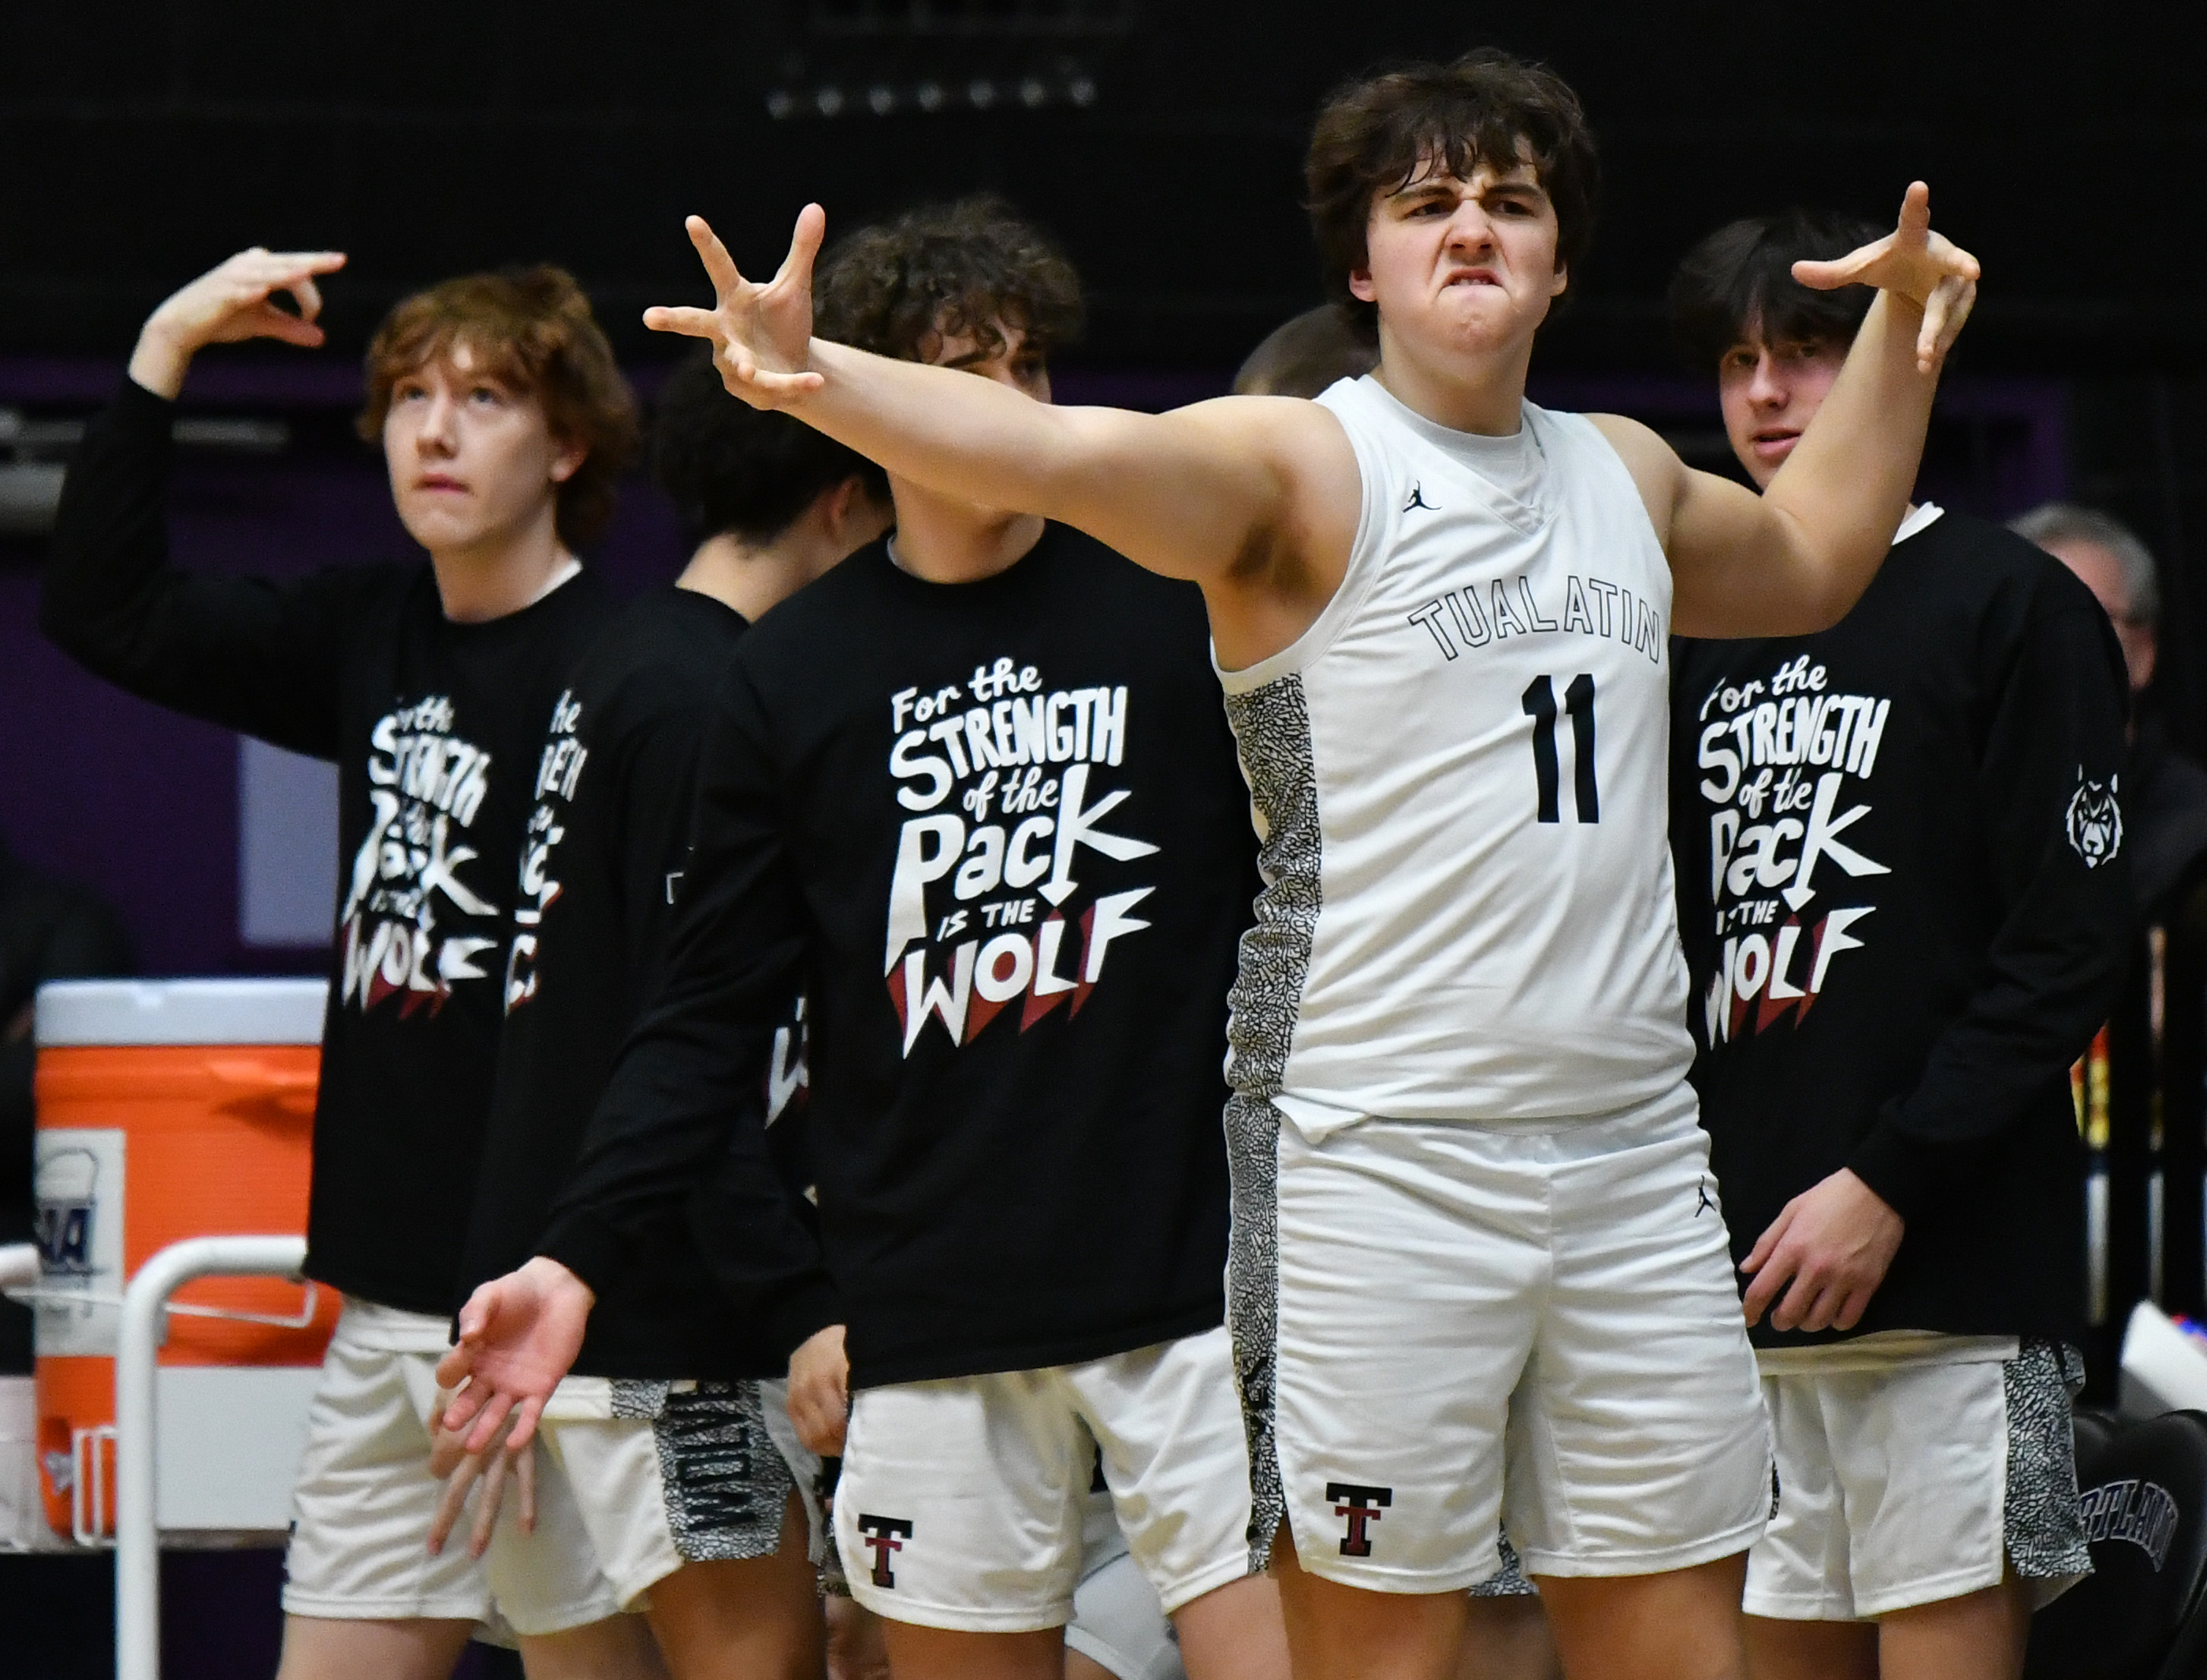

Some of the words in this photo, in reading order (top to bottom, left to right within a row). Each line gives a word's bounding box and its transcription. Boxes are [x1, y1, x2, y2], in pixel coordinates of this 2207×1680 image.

[1406, 575, 1661, 665] TUALATIN
[890, 686, 962, 734] For
[968, 656, 1043, 703] the
[1771, 654, 1829, 697] the
[888, 685, 1129, 812] STRENGTH
[1521, 673, 1600, 825] 11
[1697, 693, 1892, 805] STRENGTH
[963, 772, 997, 823] of
[1000, 766, 1060, 815] the
[1737, 767, 1774, 820] of
[935, 909, 969, 943] IS
[979, 898, 1037, 929] THE
[1737, 899, 1780, 926] THE
[894, 886, 1157, 1061] WOLF
